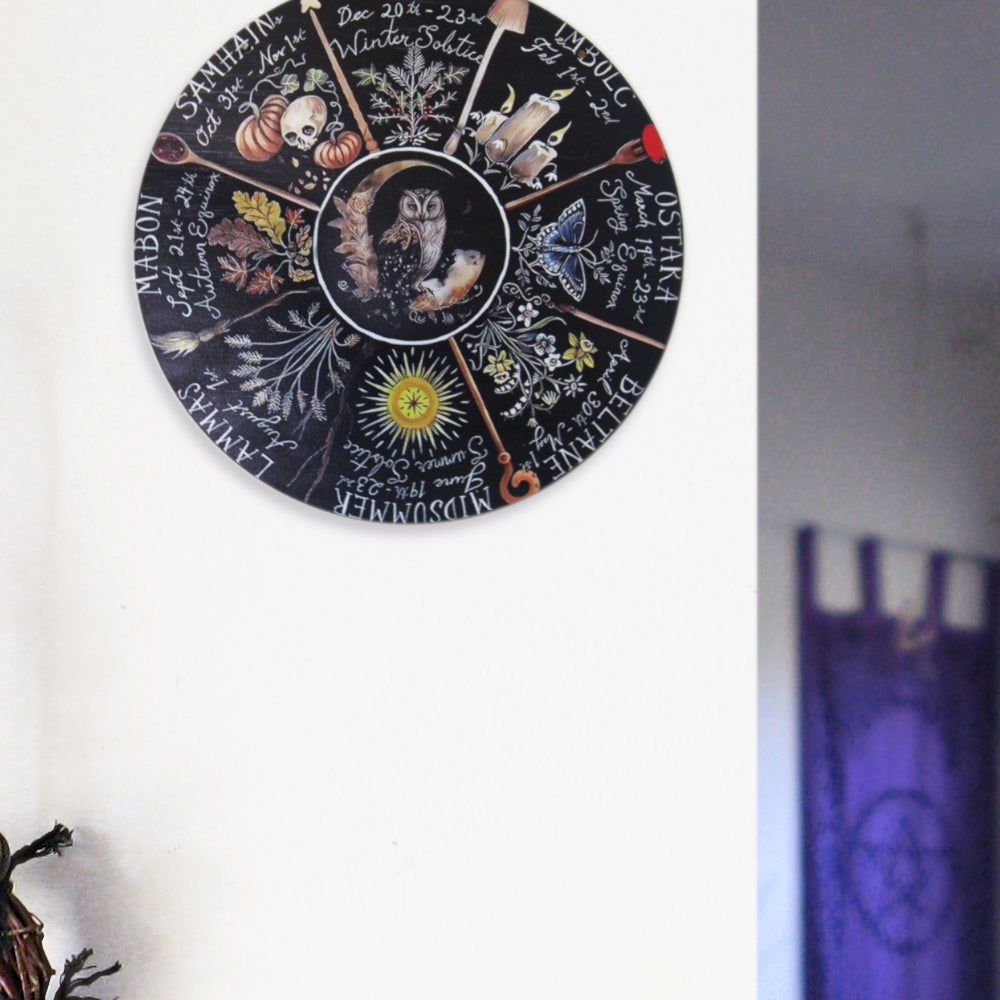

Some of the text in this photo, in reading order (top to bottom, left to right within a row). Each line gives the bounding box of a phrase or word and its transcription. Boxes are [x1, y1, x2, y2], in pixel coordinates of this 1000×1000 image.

[329, 19, 485, 64] Winter Solstice
[338, 4, 374, 27] Dec
[520, 37, 562, 65] Feb
[196, 107, 222, 146] Oct
[625, 170, 656, 228] March
[134, 192, 163, 295] MABON
[187, 172, 222, 319] Autumn Equinox
[597, 178, 637, 309] Spring Equinox
[654, 191, 684, 303] OSTARA
[161, 266, 195, 318] Sept
[597, 338, 632, 396] April
[177, 382, 275, 478] LAMMAS
[222, 400, 298, 450] August
[543, 374, 645, 480] BELTANE
[343, 435, 489, 484] Summer Solstice
[433, 461, 487, 494] June
[333, 486, 494, 524] MIDSUMMER
